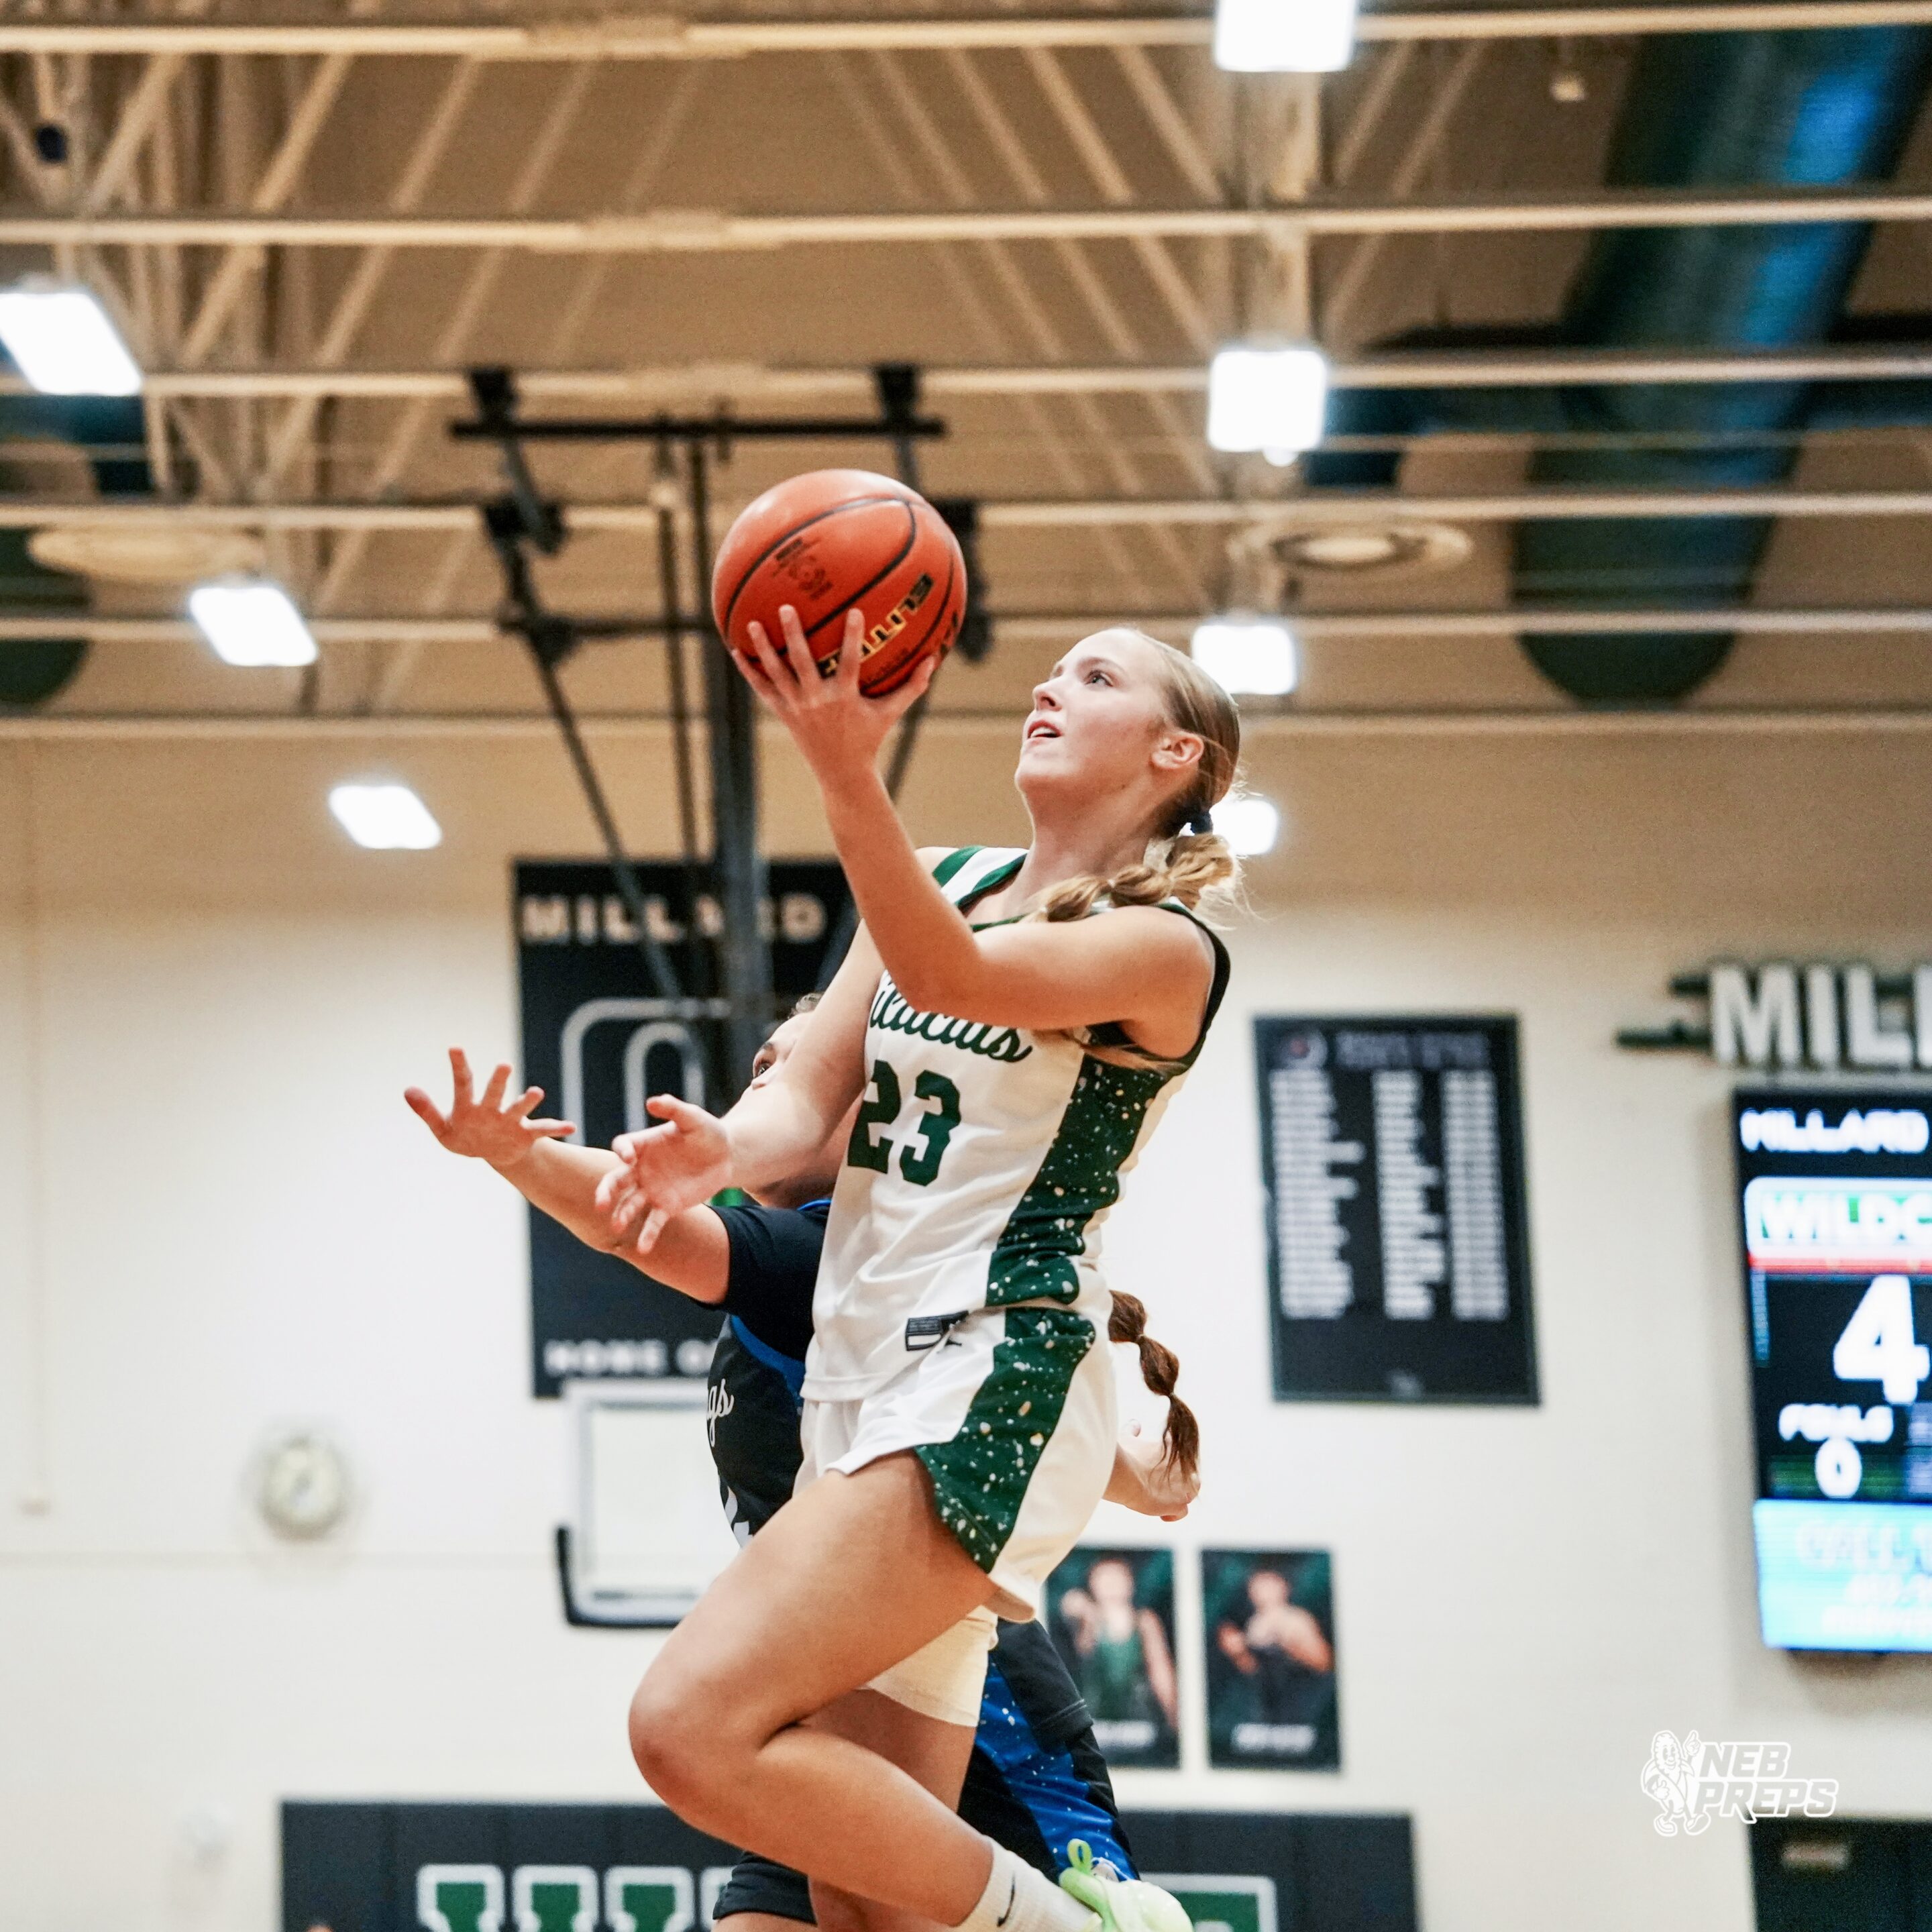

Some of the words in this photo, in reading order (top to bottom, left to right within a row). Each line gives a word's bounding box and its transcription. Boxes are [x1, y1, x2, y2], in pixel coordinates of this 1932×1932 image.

[521, 893, 827, 943] MILLD
[847, 1059, 962, 1187] 23
[1833, 1275, 1931, 1404] 4
[1815, 1440, 1862, 1499] 0
